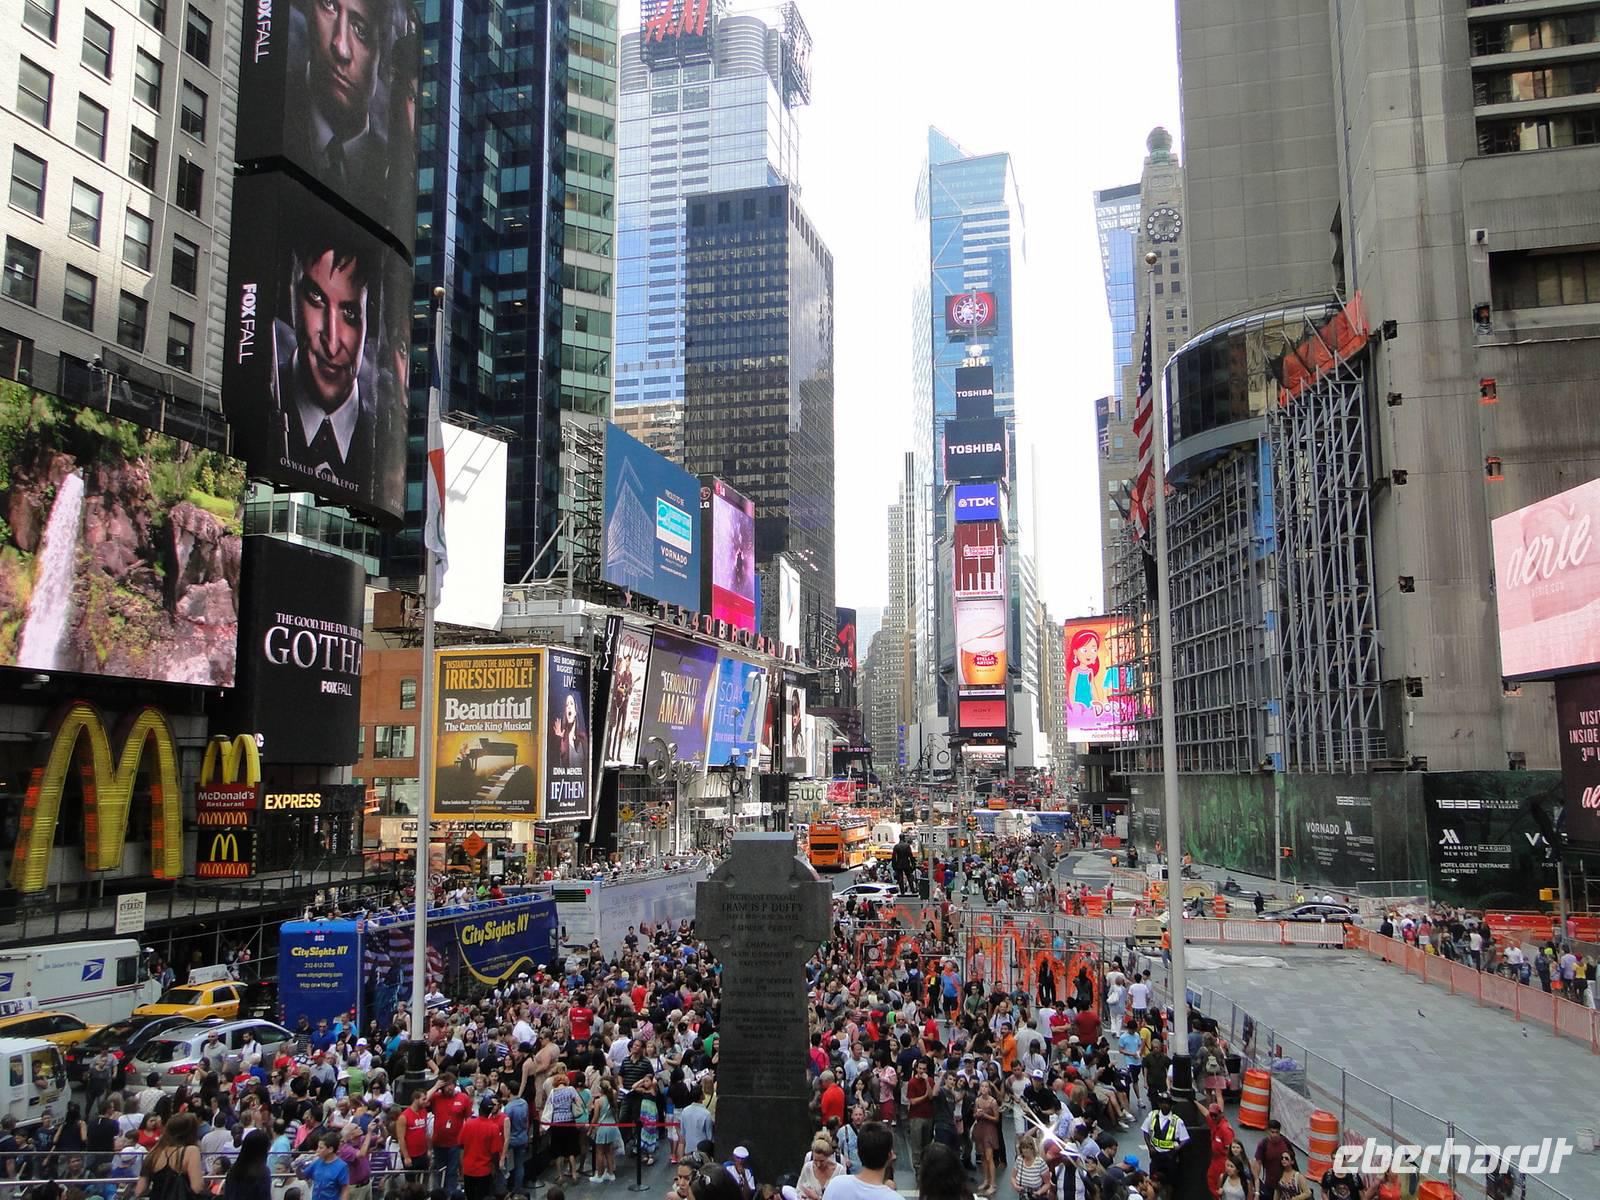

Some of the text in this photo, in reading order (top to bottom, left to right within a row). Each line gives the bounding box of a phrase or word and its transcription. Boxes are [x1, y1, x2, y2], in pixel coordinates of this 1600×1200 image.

[956, 388, 994, 398] TOSHIBA
[949, 442, 1002, 455] TOSHIBA
[280, 457, 314, 476] OSWALD
[967, 497, 996, 508] TDK
[1506, 503, 1592, 590] aerie
[660, 545, 688, 566] VORNADO
[275, 612, 294, 625] THE
[320, 620, 336, 633] THE
[563, 675, 577, 688] LIVE
[445, 696, 533, 720] Beautiful
[444, 721, 532, 733] The Carole King Musical
[1569, 728, 1599, 744] INSIDE
[198, 790, 255, 801] McDonald's
[551, 779, 585, 802] IF/THEN
[264, 793, 322, 810] EXPRESS
[1436, 799, 1481, 810] 1535
[1306, 822, 1340, 835] VORNADO
[919, 833, 937, 843] TIE
[771, 903, 803, 912] DUFFY
[461, 912, 530, 946] CitySights NY
[291, 945, 349, 957] CitySights NY
